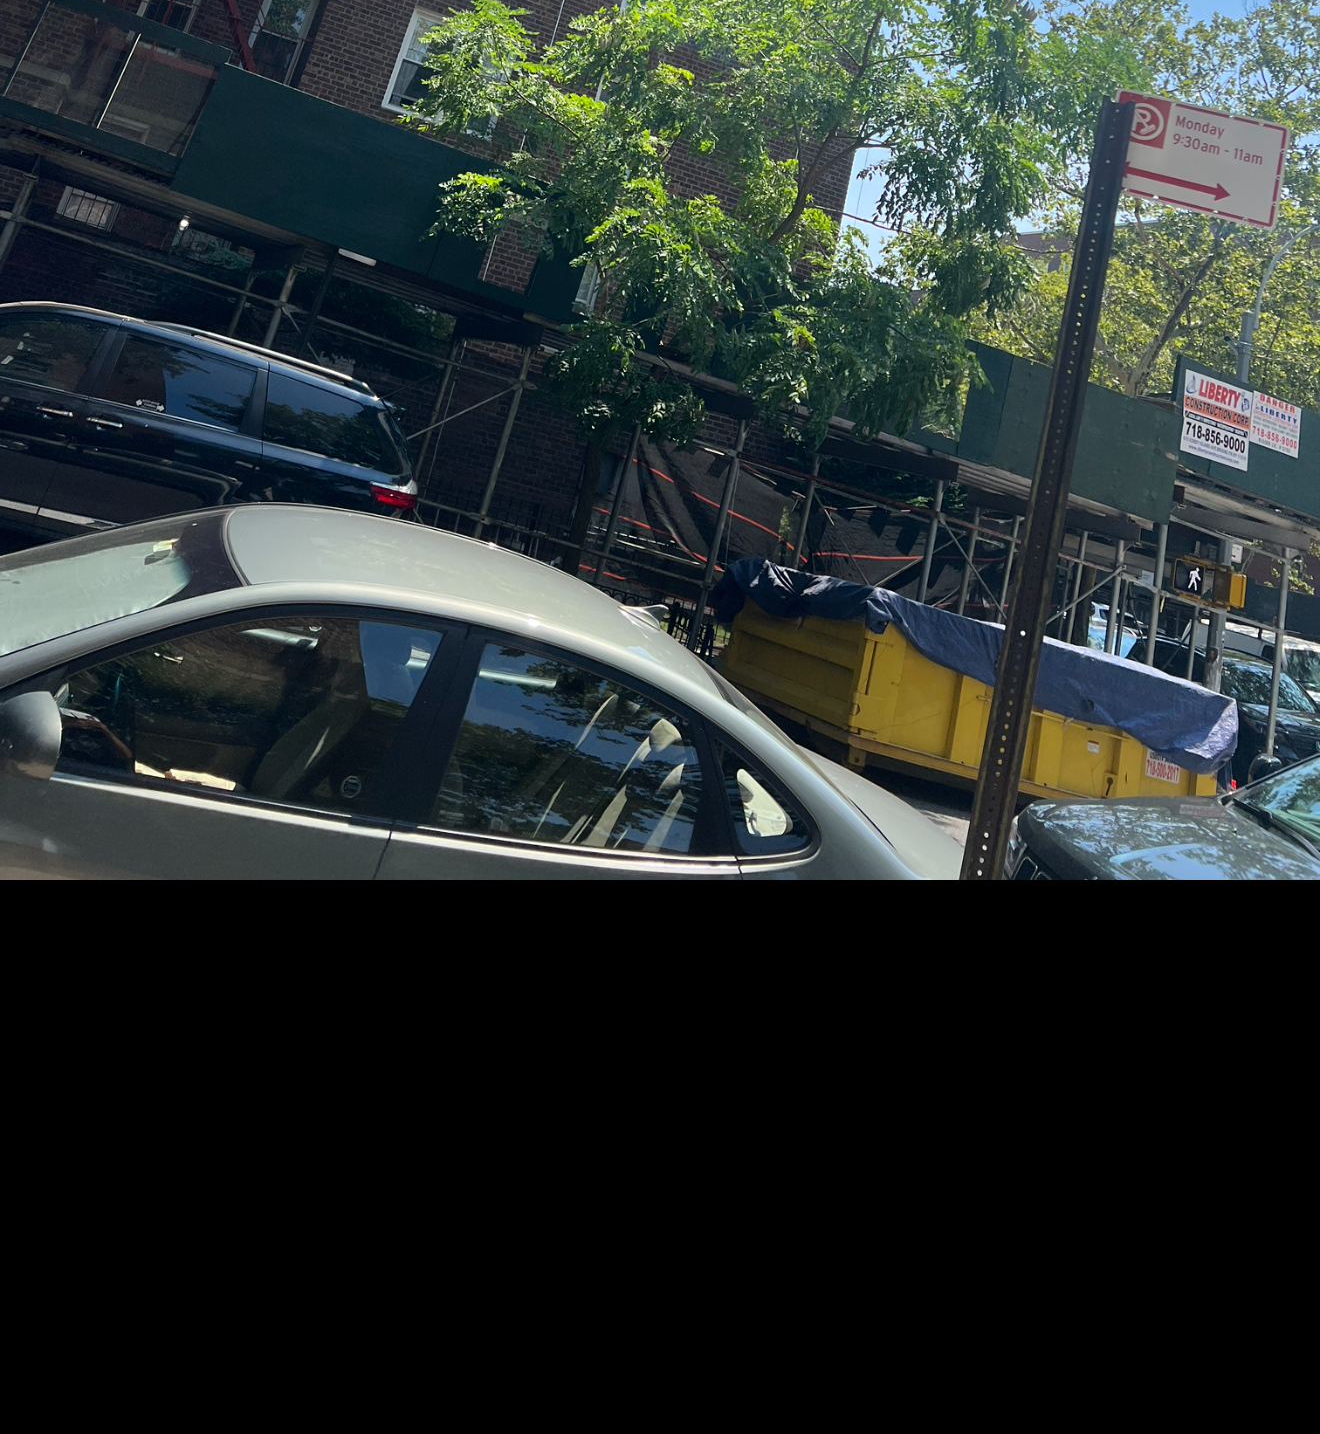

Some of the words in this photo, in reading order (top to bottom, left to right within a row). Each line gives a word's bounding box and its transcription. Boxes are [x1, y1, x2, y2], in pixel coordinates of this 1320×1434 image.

[1175, 115, 1225, 139] Monday
[1173, 133, 1220, 156] 9:30am
[1233, 148, 1263, 166] 11am
[1199, 379, 1241, 408] LIBERTY
[1260, 394, 1295, 413] DANGER
[1185, 396, 1231, 421] CONSTRUCTION
[1260, 406, 1297, 424] LIBERTY
[1186, 421, 1246, 454] 718-856-9000
[1252, 425, 1297, 450] 718-856-9000
